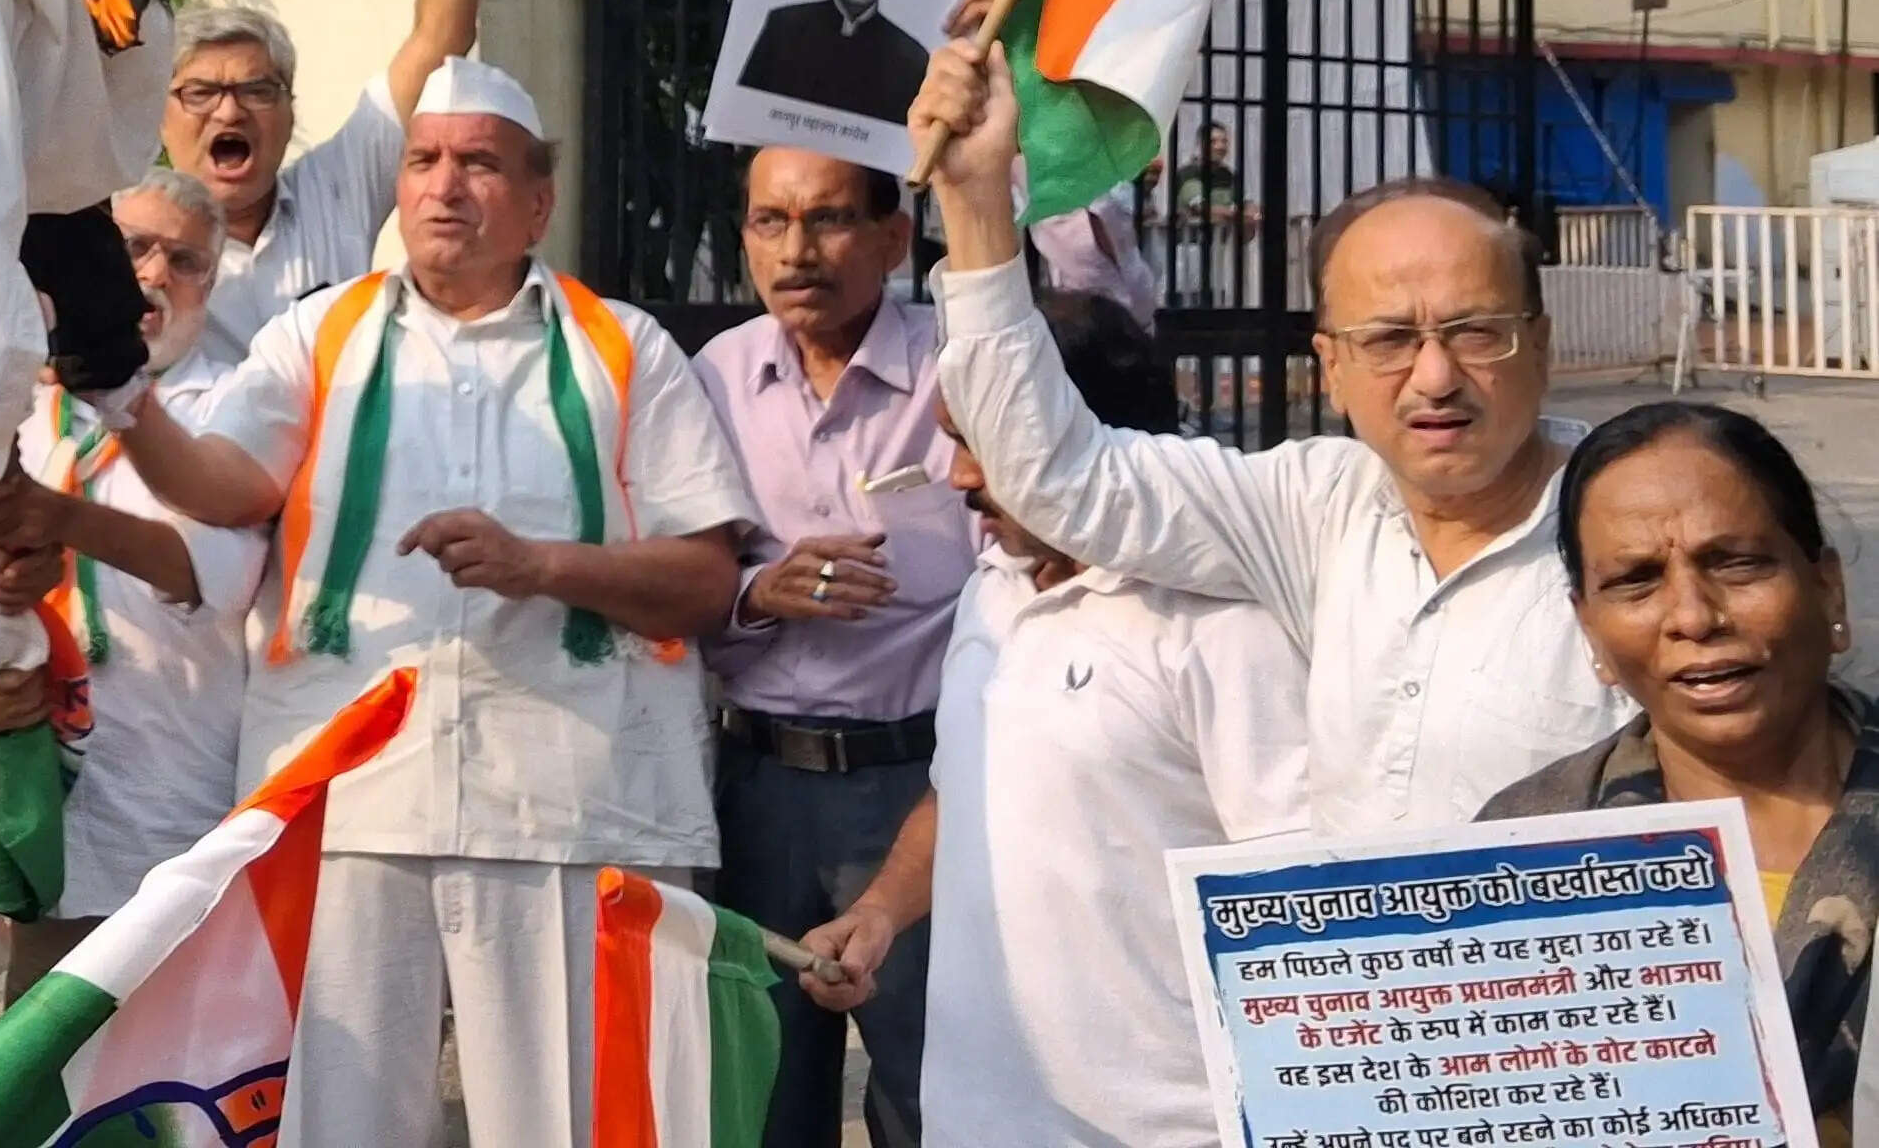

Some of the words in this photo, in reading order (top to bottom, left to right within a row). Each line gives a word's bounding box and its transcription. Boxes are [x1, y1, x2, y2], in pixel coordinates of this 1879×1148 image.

[1209, 893, 1291, 940] मुख्य
[1293, 885, 1376, 933] चुनाव
[1381, 877, 1475, 922] आयुक्त
[1476, 864, 1525, 906] को
[1527, 853, 1640, 902] बर्खास्त
[1645, 846, 1715, 890] करो
[1236, 959, 1277, 981] हम
[1281, 947, 1353, 979] पिछले
[1357, 950, 1404, 980] कुछ
[1408, 937, 1454, 969] वर्षों
[1458, 936, 1486, 965] से
[1489, 938, 1530, 960] यह
[1534, 933, 1583, 965] मुद्दा
[1588, 929, 1632, 953] उठा
[1636, 919, 1674, 949] रहे
[1239, 995, 1300, 1025] मुख्य
[1304, 990, 1370, 1022] चुनाव
[1378, 984, 1452, 1014] आयुक्त
[1458, 968, 1577, 1004] प्रधानमंत्री
[1584, 963, 1633, 991] और
[1639, 961, 1722, 986] भाजपा
[1296, 1022, 1322, 1049] के
[1325, 1019, 1383, 1047] एजेंट
[1386, 1016, 1413, 1043] के
[1463, 1009, 1487, 1037] में
[1492, 1010, 1550, 1035] काम
[1553, 1005, 1599, 1029] कर
[1603, 996, 1639, 1025] रहे
[1274, 1065, 1310, 1087] वह
[1312, 1063, 1355, 1087] इस
[1358, 1055, 1401, 1082] देश
[1404, 1052, 1431, 1079] के
[1438, 1053, 1491, 1076] आम
[1495, 1041, 1558, 1072] लोगों
[1562, 1039, 1588, 1066] के
[1593, 1036, 1638, 1064] वोट
[1641, 1028, 1716, 1060] काटने
[1374, 1087, 1408, 1115] की
[1412, 1083, 1500, 1112] कोशिश
[1504, 1083, 1547, 1105] कर
[1550, 1073, 1586, 1102] रहे
[1414, 1127, 1450, 1148] पर
[1453, 1117, 1495, 1146] बने
[1498, 1113, 1556, 1143] रहने
[1559, 1116, 1595, 1139] का
[1598, 1105, 1651, 1137] कोई
[1657, 1101, 1760, 1131] अधिकार
